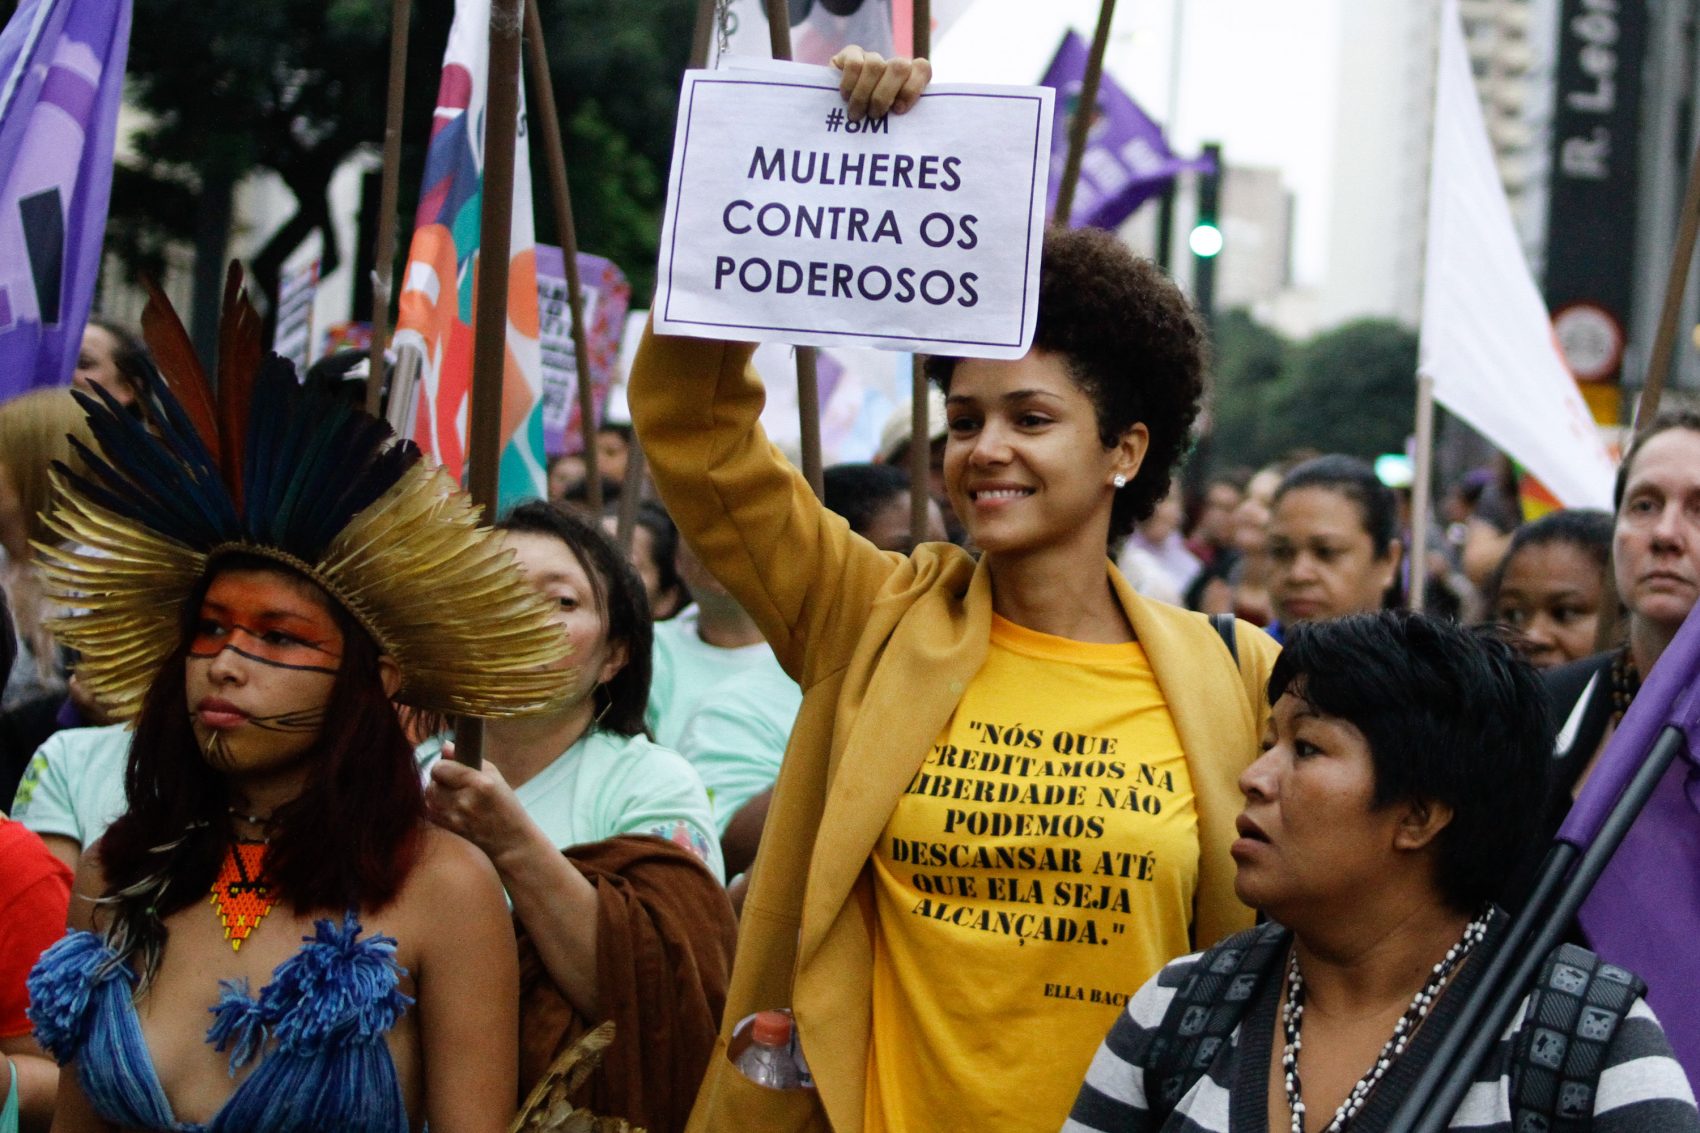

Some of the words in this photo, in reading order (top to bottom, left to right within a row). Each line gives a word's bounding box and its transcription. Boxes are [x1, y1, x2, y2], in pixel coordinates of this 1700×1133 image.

[748, 146, 961, 191] MULHERES
[723, 200, 902, 245] CONTRA
[919, 212, 978, 249] OS
[715, 256, 978, 307] PODEROSOS
[969, 721, 1043, 749] "NÓS
[1053, 731, 1118, 755] QUE
[904, 772, 1086, 806] LIBERDADE
[1096, 786, 1161, 815] NÃO
[1136, 763, 1174, 793] NA
[944, 809, 1104, 839] PODEMOS
[892, 837, 1083, 873] DESCANSAR
[1093, 851, 1156, 881] ATÉ
[912, 873, 977, 897] QUE
[988, 878, 1043, 904] ELA
[1054, 882, 1131, 913] SEJA
[912, 898, 1125, 946] ALCANÇADA."
[1044, 983, 1084, 1000] ELLA
